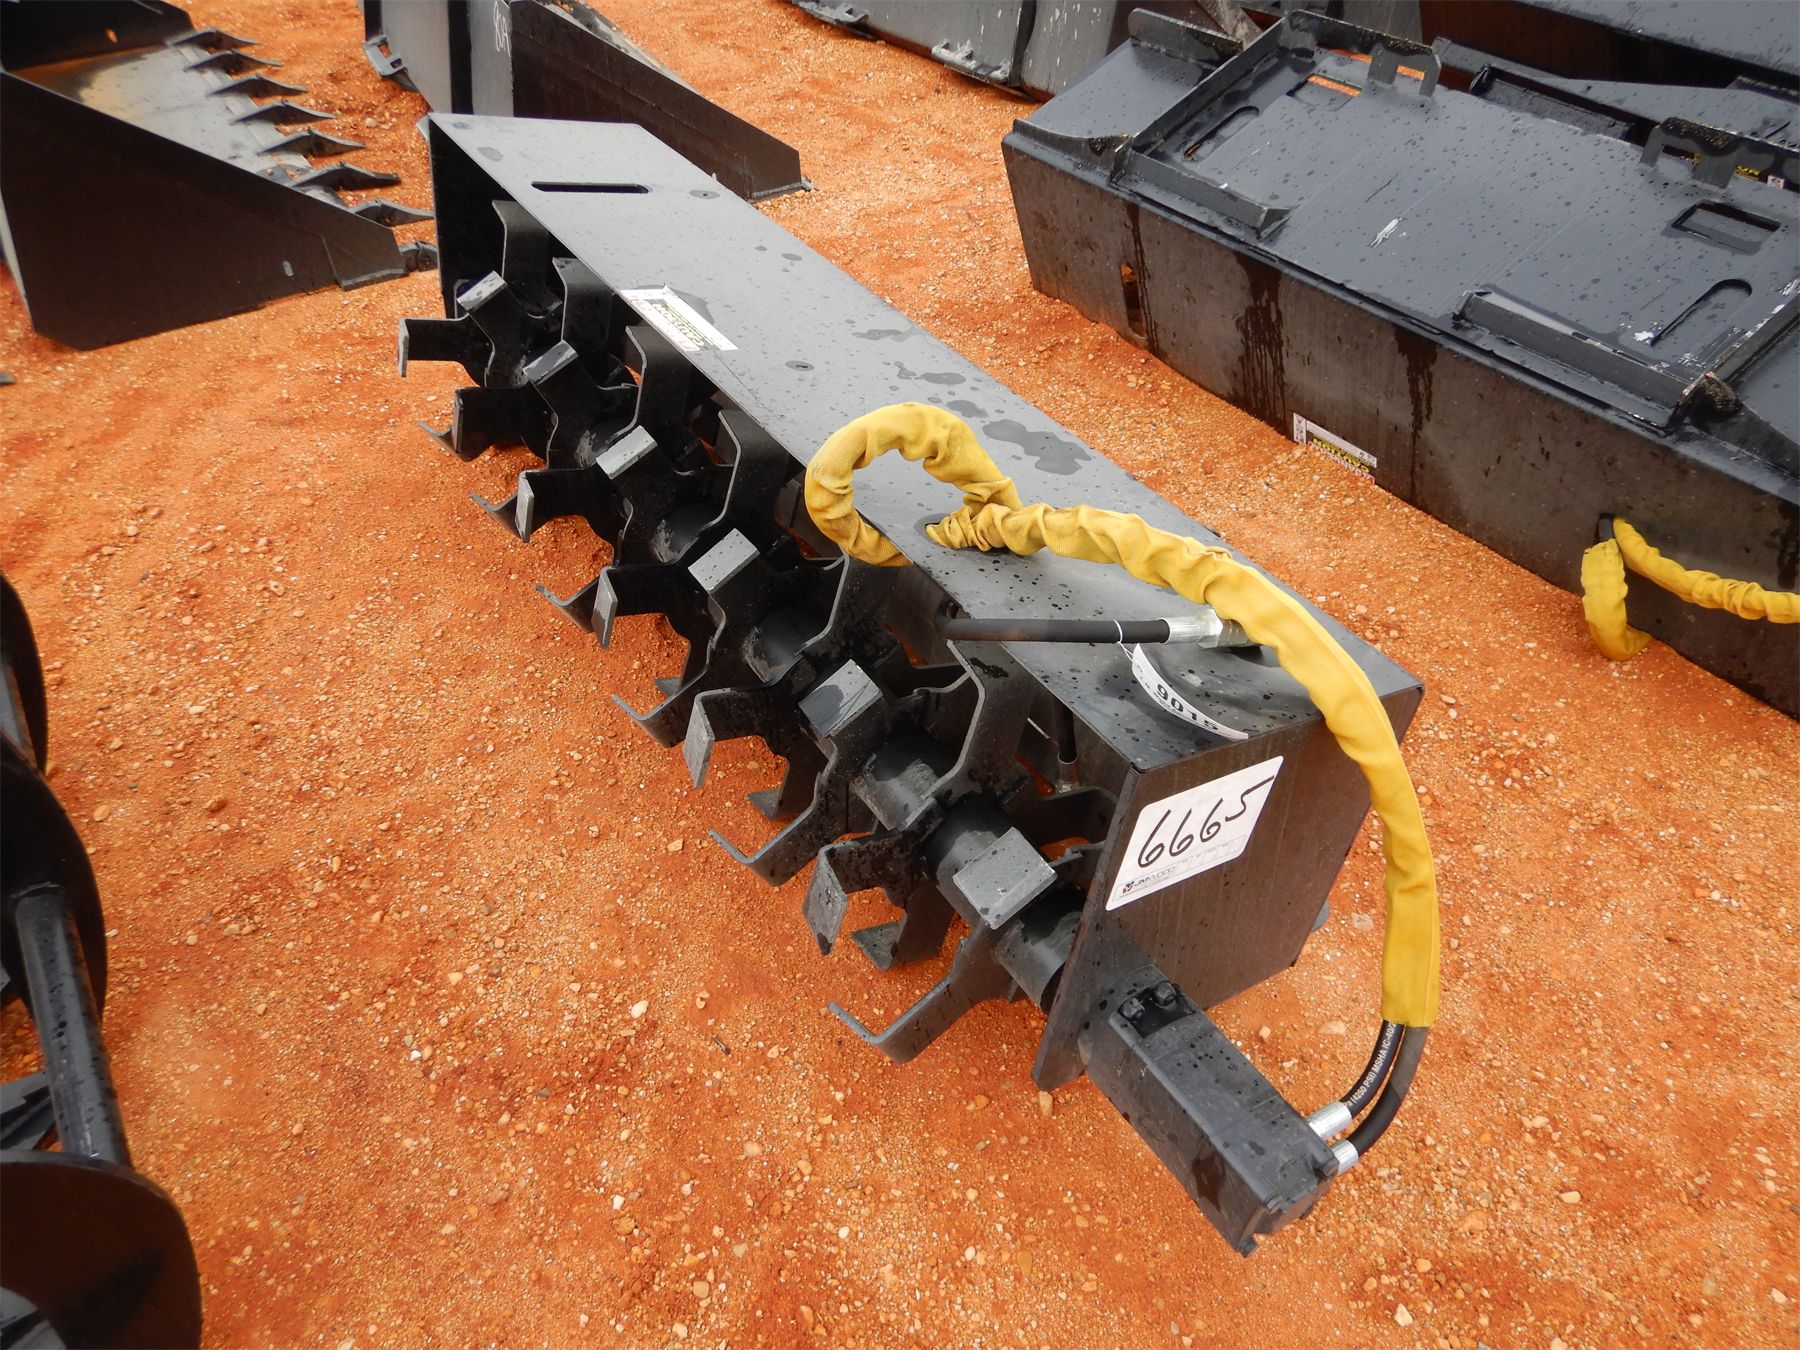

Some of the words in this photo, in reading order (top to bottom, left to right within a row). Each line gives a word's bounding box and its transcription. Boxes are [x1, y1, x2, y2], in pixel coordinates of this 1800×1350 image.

[1313, 438, 1369, 473] CAUTION
[1157, 683, 1218, 730] 9015
[1138, 775, 1275, 868] 6665
[1351, 1086, 1366, 1104] (4250
[1371, 1049, 1388, 1074] MSHA
